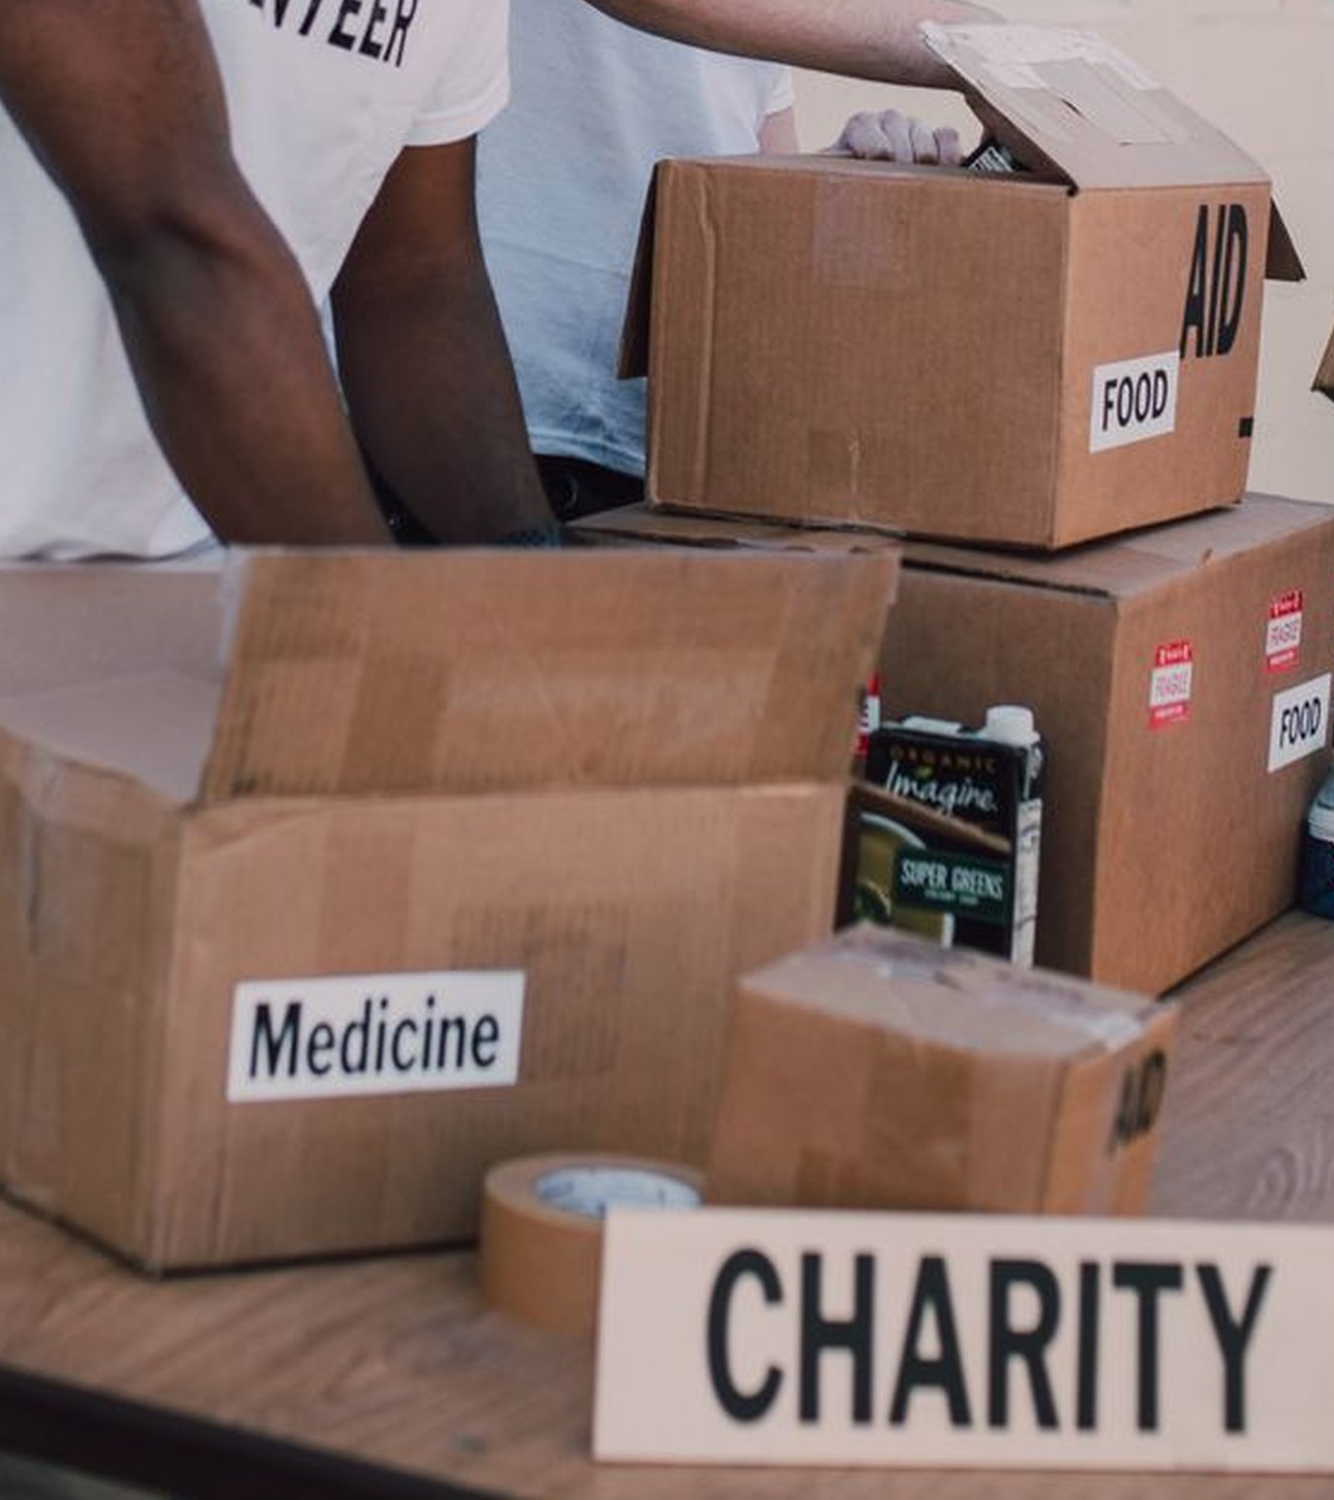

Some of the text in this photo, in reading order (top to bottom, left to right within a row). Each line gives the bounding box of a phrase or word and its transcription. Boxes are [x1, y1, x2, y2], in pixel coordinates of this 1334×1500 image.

[1178, 203, 1248, 360] AID
[1102, 369, 1168, 432] FOOD
[1279, 696, 1322, 749] FOOD
[901, 858, 947, 890] SUPER
[951, 866, 1004, 901] GREENS
[248, 995, 501, 1079] Medicine
[706, 1247, 1273, 1435] CHARITY
